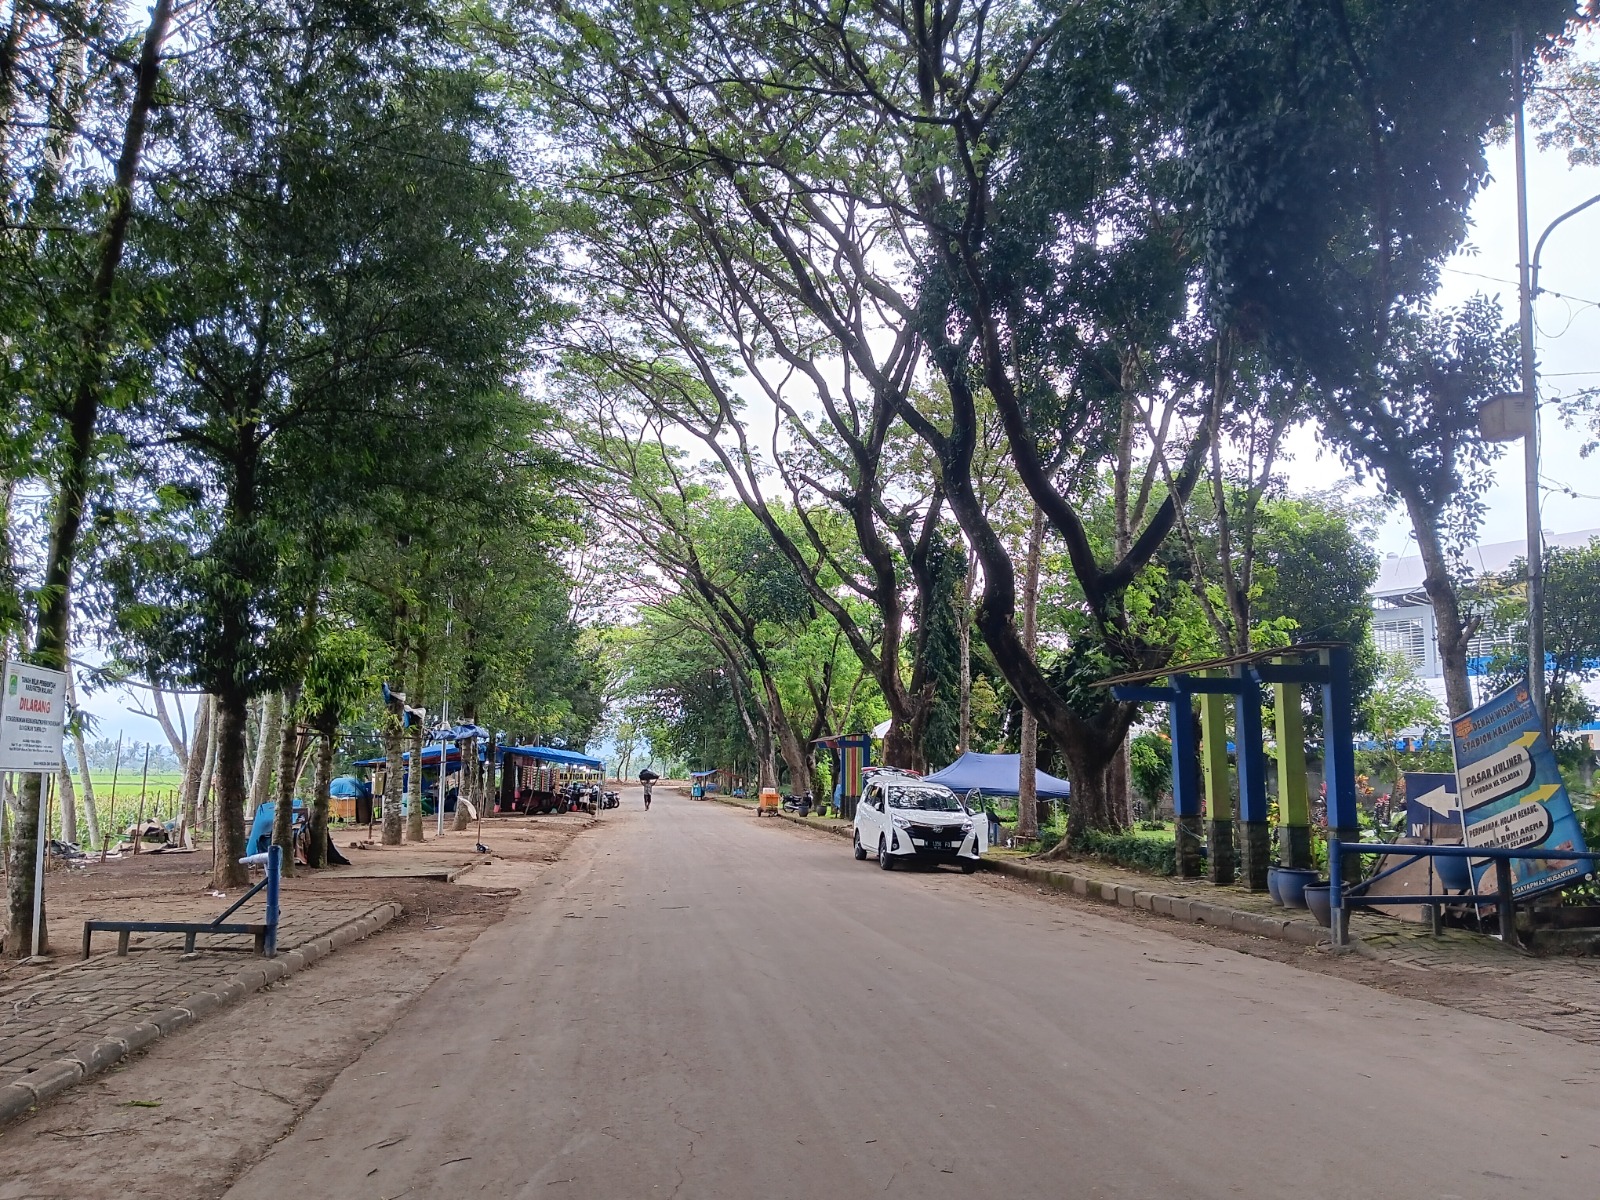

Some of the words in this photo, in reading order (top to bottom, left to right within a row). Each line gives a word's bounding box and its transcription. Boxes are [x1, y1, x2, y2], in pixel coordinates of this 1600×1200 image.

[19, 697, 51, 714] DILARANG
[1473, 713, 1495, 732] DENAH
[1494, 700, 1519, 720] WISATA
[1462, 730, 1493, 753] STADION
[1493, 709, 1534, 739] KANJURUHAN
[1466, 768, 1493, 787] PASAR
[1493, 753, 1523, 776] KULINER
[1499, 770, 1521, 784] SELATAN
[1500, 813, 1518, 826] KOLAM
[1501, 831, 1519, 843] BUMI
[1519, 820, 1544, 836] AREMA
[1546, 867, 1579, 883] NUSANTARA
